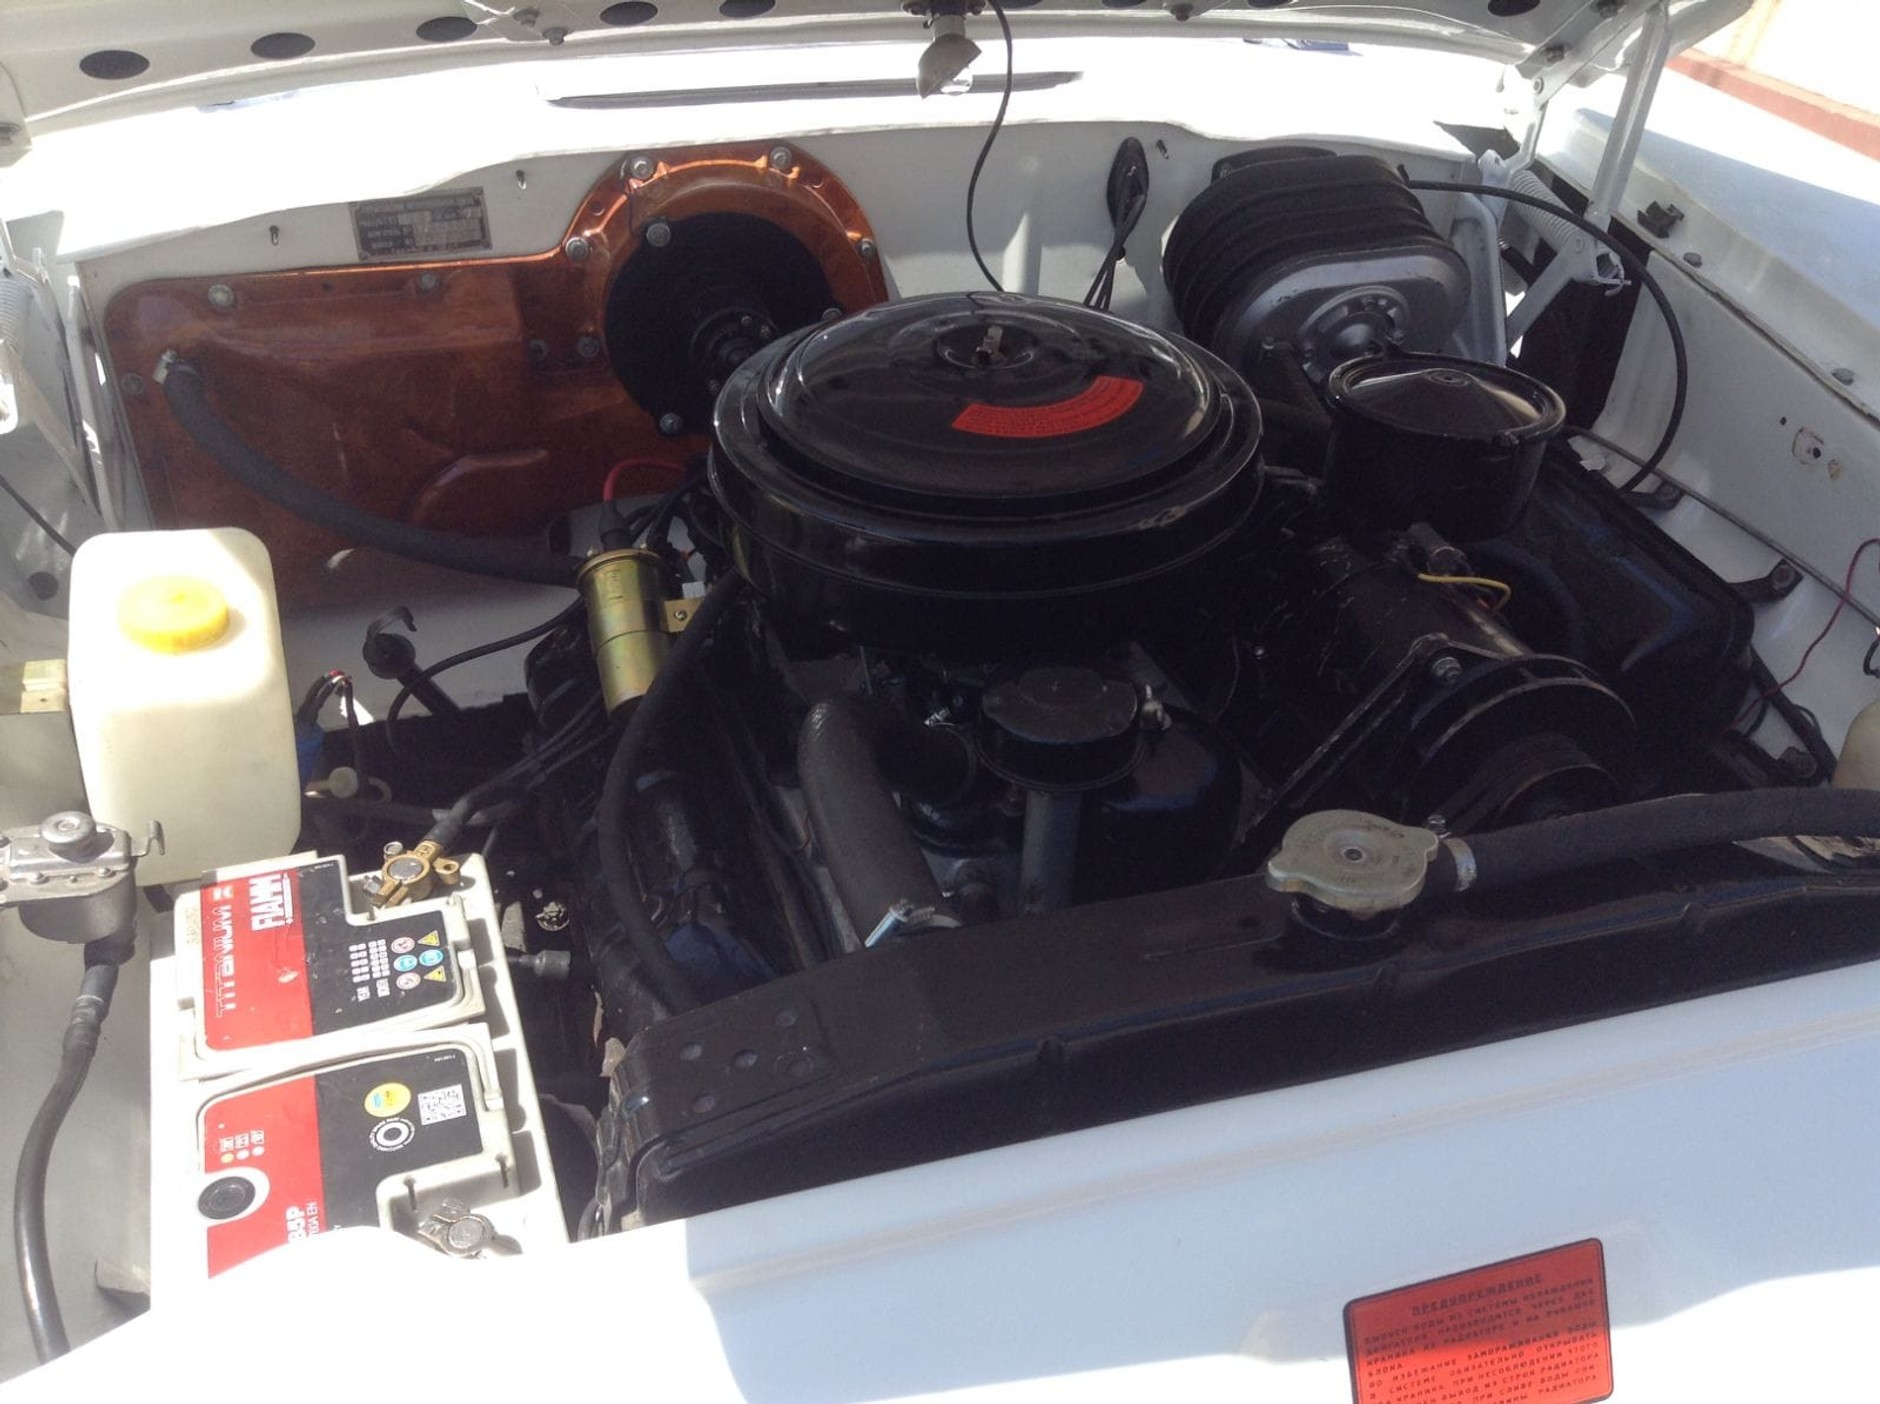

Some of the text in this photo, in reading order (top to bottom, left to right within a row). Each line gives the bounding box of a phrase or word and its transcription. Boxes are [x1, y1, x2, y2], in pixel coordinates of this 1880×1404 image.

[249, 873, 285, 931] FIAMM
[1412, 1273, 1541, 1316] ПРЕДУПРЕЖДЕНИЕ
[1389, 1374, 1435, 1393] СИСТЕМЕ
[1449, 1350, 1524, 1376] ОБЯЗАТЕЛЬНО
[1536, 1330, 1597, 1353] ОТКРЫВАТЬ
[1392, 1358, 1456, 1381] ИЗБЕЖАНИЕ
[1540, 1351, 1598, 1373] РАДИАТОРА
[1453, 1375, 1473, 1386] ПРИ
[1538, 1373, 1596, 1395] РАДИАТОРА
[1540, 1370, 1568, 1384] ВОДЫ
